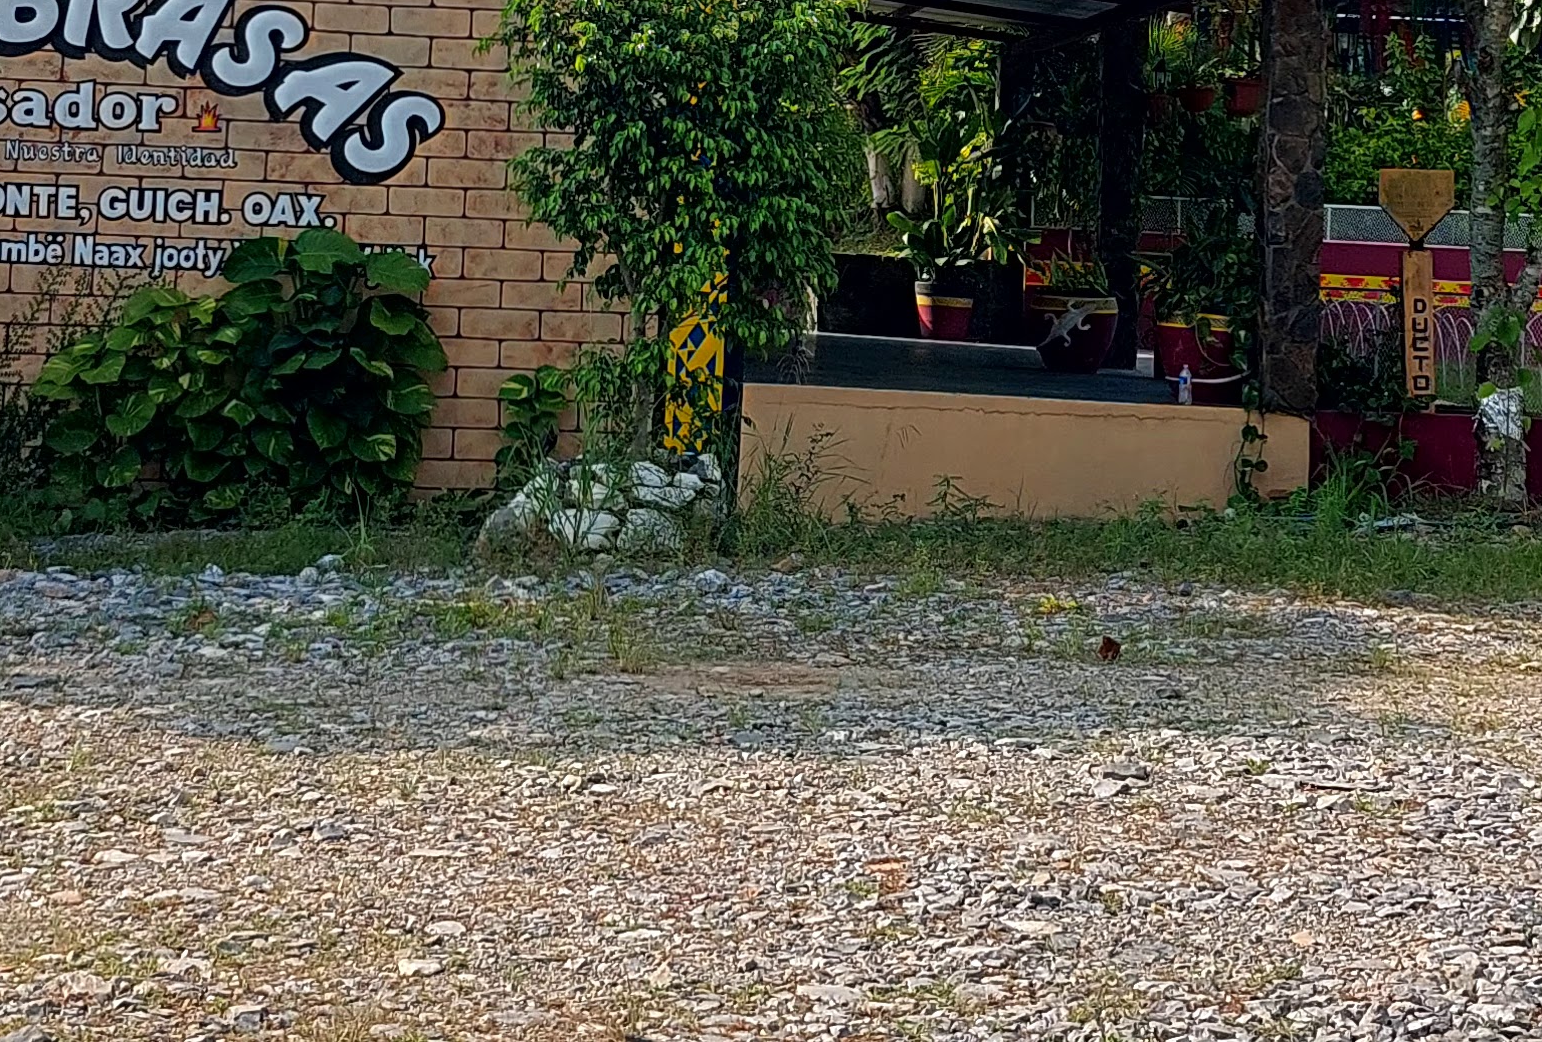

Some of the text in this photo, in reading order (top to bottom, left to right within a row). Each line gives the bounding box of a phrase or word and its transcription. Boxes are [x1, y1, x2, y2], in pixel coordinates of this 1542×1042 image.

[4, 139, 105, 164] Nuestra
[116, 144, 238, 169] Identidad
[98, 186, 233, 226] GUICH.
[241, 191, 338, 229] OAX.
[72, 234, 146, 267] Naax
